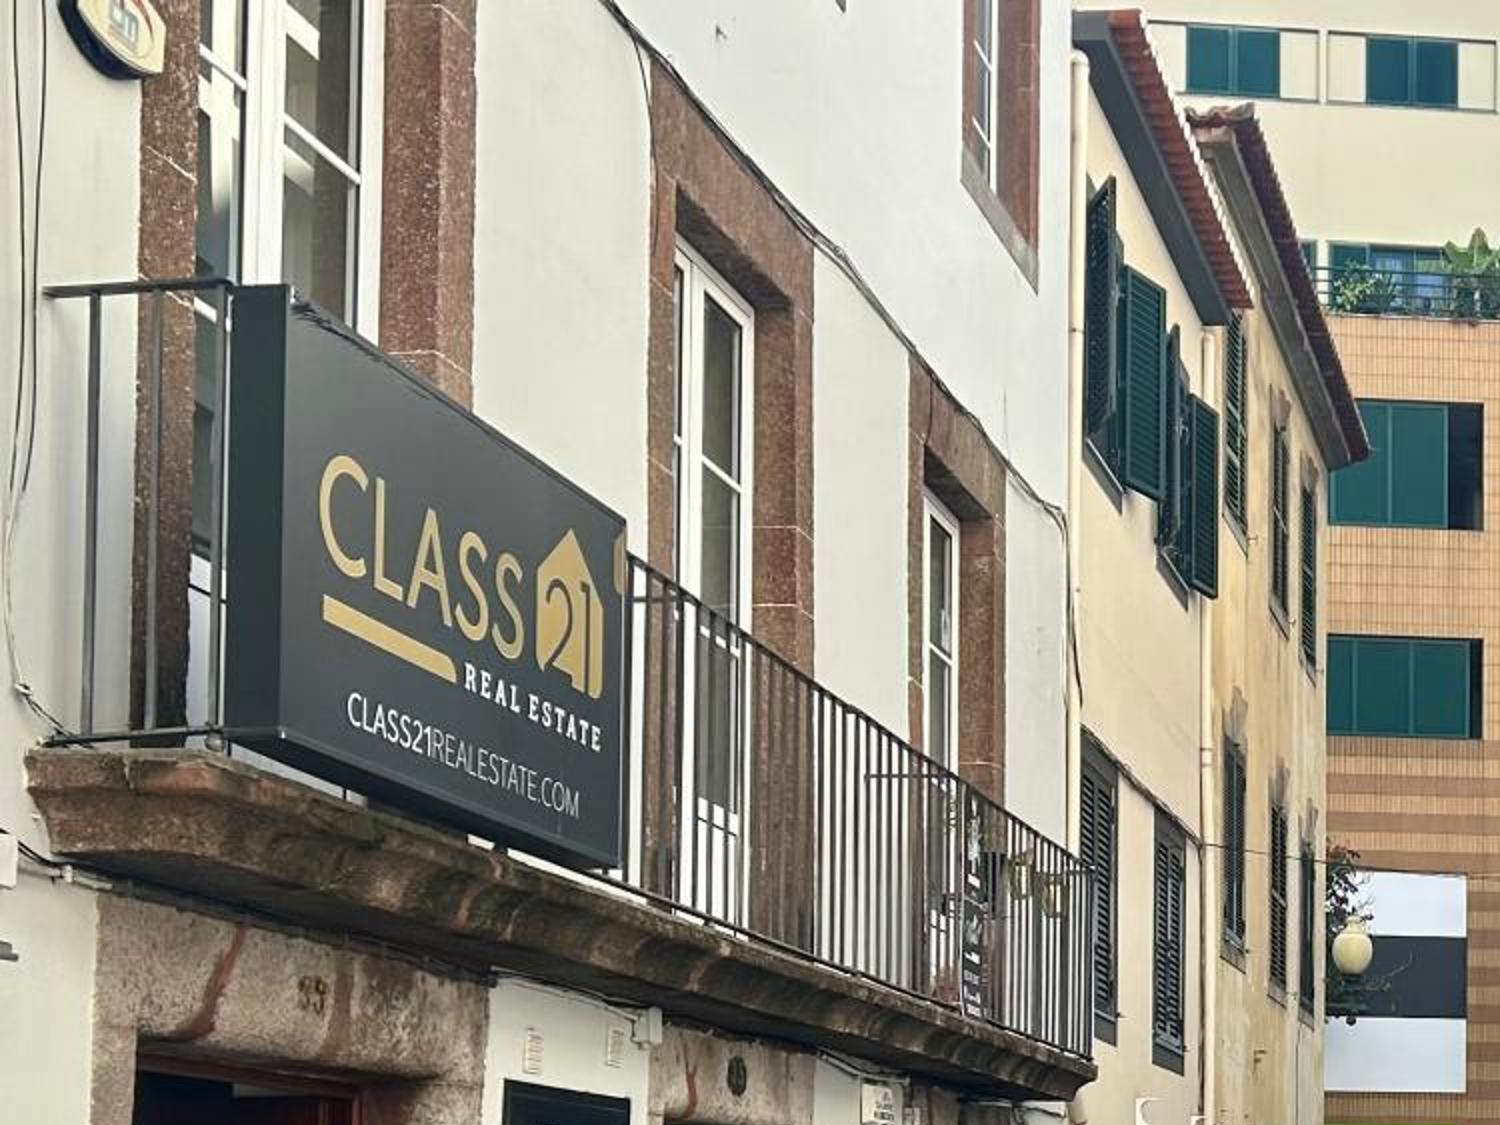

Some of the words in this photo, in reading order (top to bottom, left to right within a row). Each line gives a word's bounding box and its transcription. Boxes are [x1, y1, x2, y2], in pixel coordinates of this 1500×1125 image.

[319, 455, 525, 660] CLASS
[347, 692, 580, 819] CLASS21REALESTATE.COM
[464, 661, 521, 713] REAL
[528, 702, 602, 752] ESTATE
